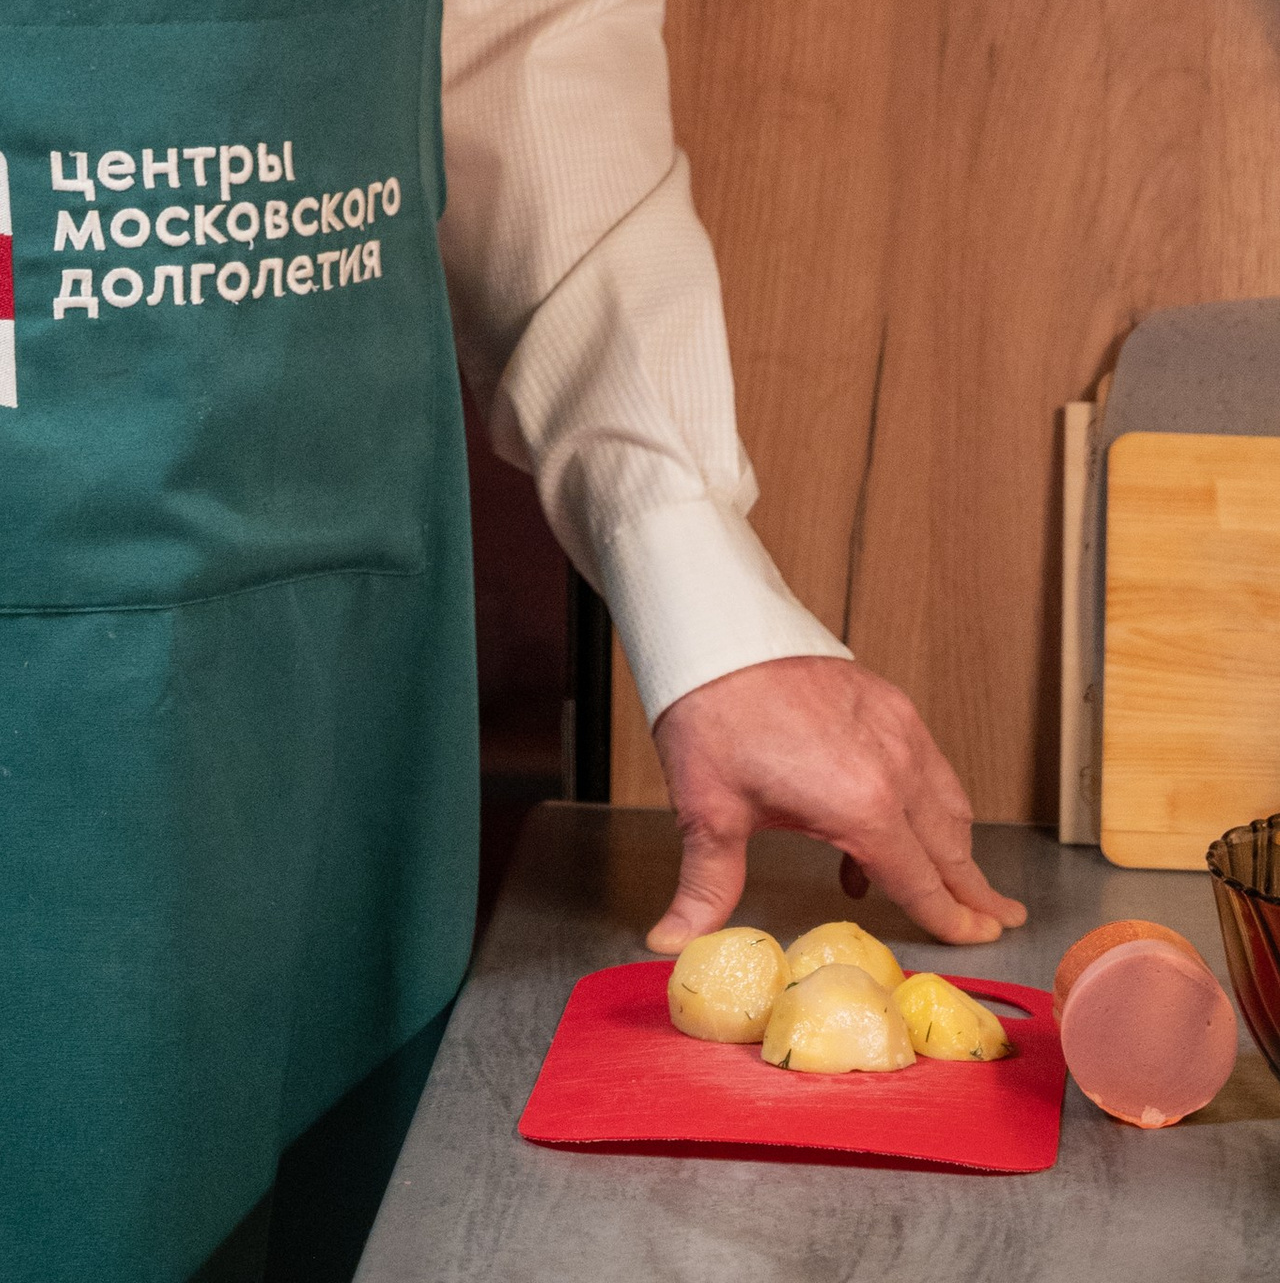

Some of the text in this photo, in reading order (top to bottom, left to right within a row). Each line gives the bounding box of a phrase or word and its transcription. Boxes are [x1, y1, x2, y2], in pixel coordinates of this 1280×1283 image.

[50, 141, 295, 201] центры
[52, 176, 401, 252] московского
[52, 240, 383, 320] долголетия
